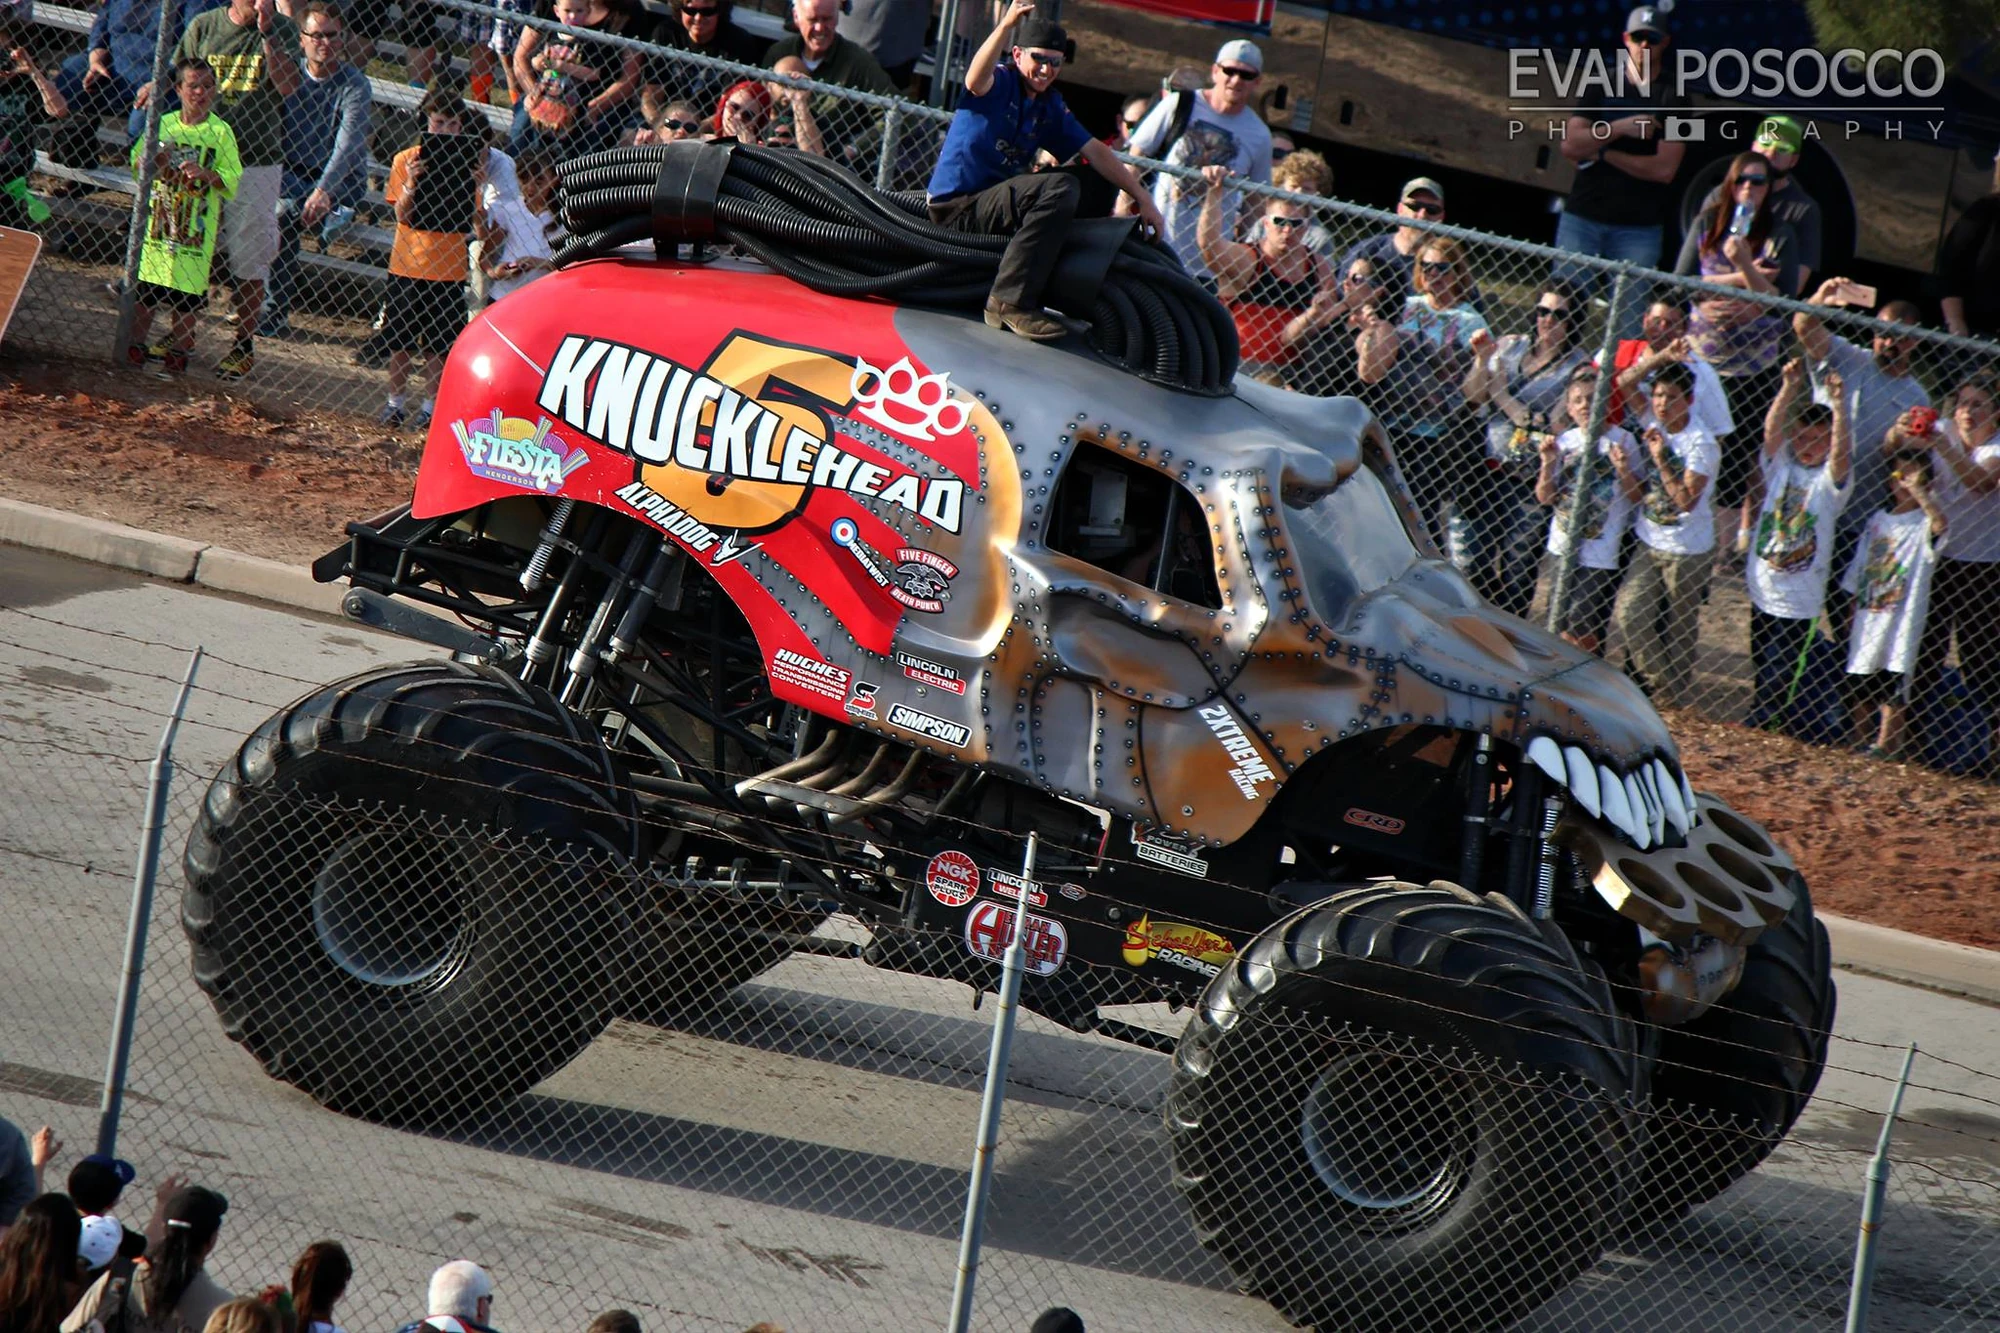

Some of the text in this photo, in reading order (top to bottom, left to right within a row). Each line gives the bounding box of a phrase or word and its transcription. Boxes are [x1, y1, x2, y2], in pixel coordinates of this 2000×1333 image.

[537, 336, 964, 535] KNUCKLEHEAD
[468, 431, 564, 490] FIESTA
[485, 470, 534, 487] HENDERSON
[614, 481, 720, 552] ALPHADOG
[847, 540, 889, 587] MEDIATWIST
[900, 550, 954, 577] FIVE FINGER
[892, 588, 941, 611] DEATH PUNCH
[773, 659, 847, 690] PERFORMANCE
[775, 648, 851, 683] HUGHES
[900, 654, 956, 679] LINCOLN
[771, 665, 846, 696] TRANSMISSIONS
[771, 671, 842, 701] CONVERTERS
[911, 670, 960, 691] ELECTRIC
[1198, 704, 1276, 785] 2XTREME
[1228, 768, 1260, 800] RACING
[1146, 835, 1188, 853] POWER
[937, 861, 972, 882] NGK
[1140, 846, 1206, 873] BATTERIES
[932, 883, 966, 900] PLUGS
[934, 876, 969, 893] SPARK
[990, 871, 1039, 893] LINCON
[998, 885, 1040, 904] WELRS
[1157, 947, 1221, 979] RACING
